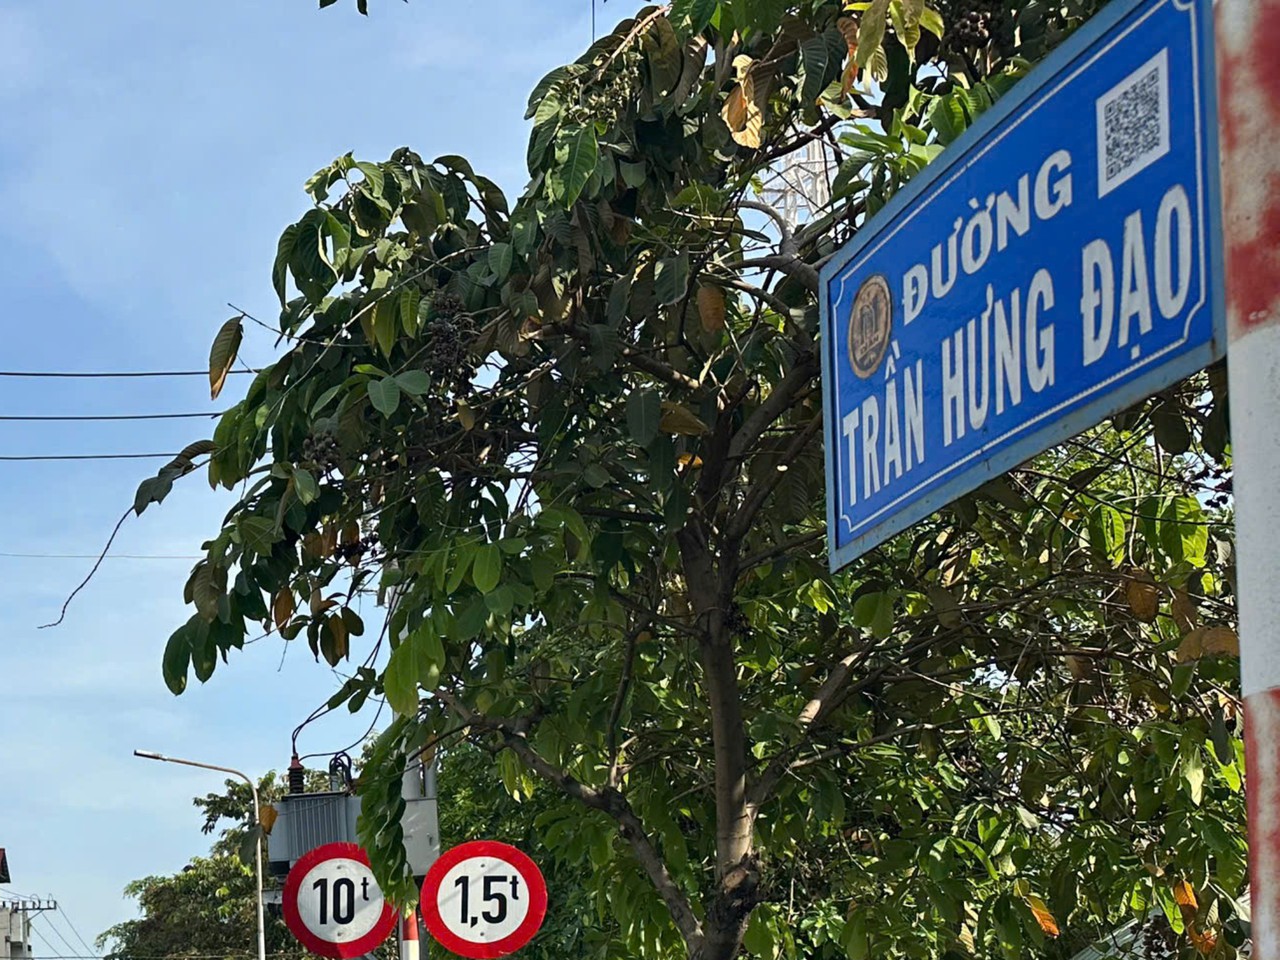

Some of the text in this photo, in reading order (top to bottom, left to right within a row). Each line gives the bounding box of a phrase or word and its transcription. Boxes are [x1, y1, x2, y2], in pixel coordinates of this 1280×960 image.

[843, 184, 1193, 507] TRẦN HƯNG ĐẠO
[902, 149, 1072, 326] ĐƯỜNG
